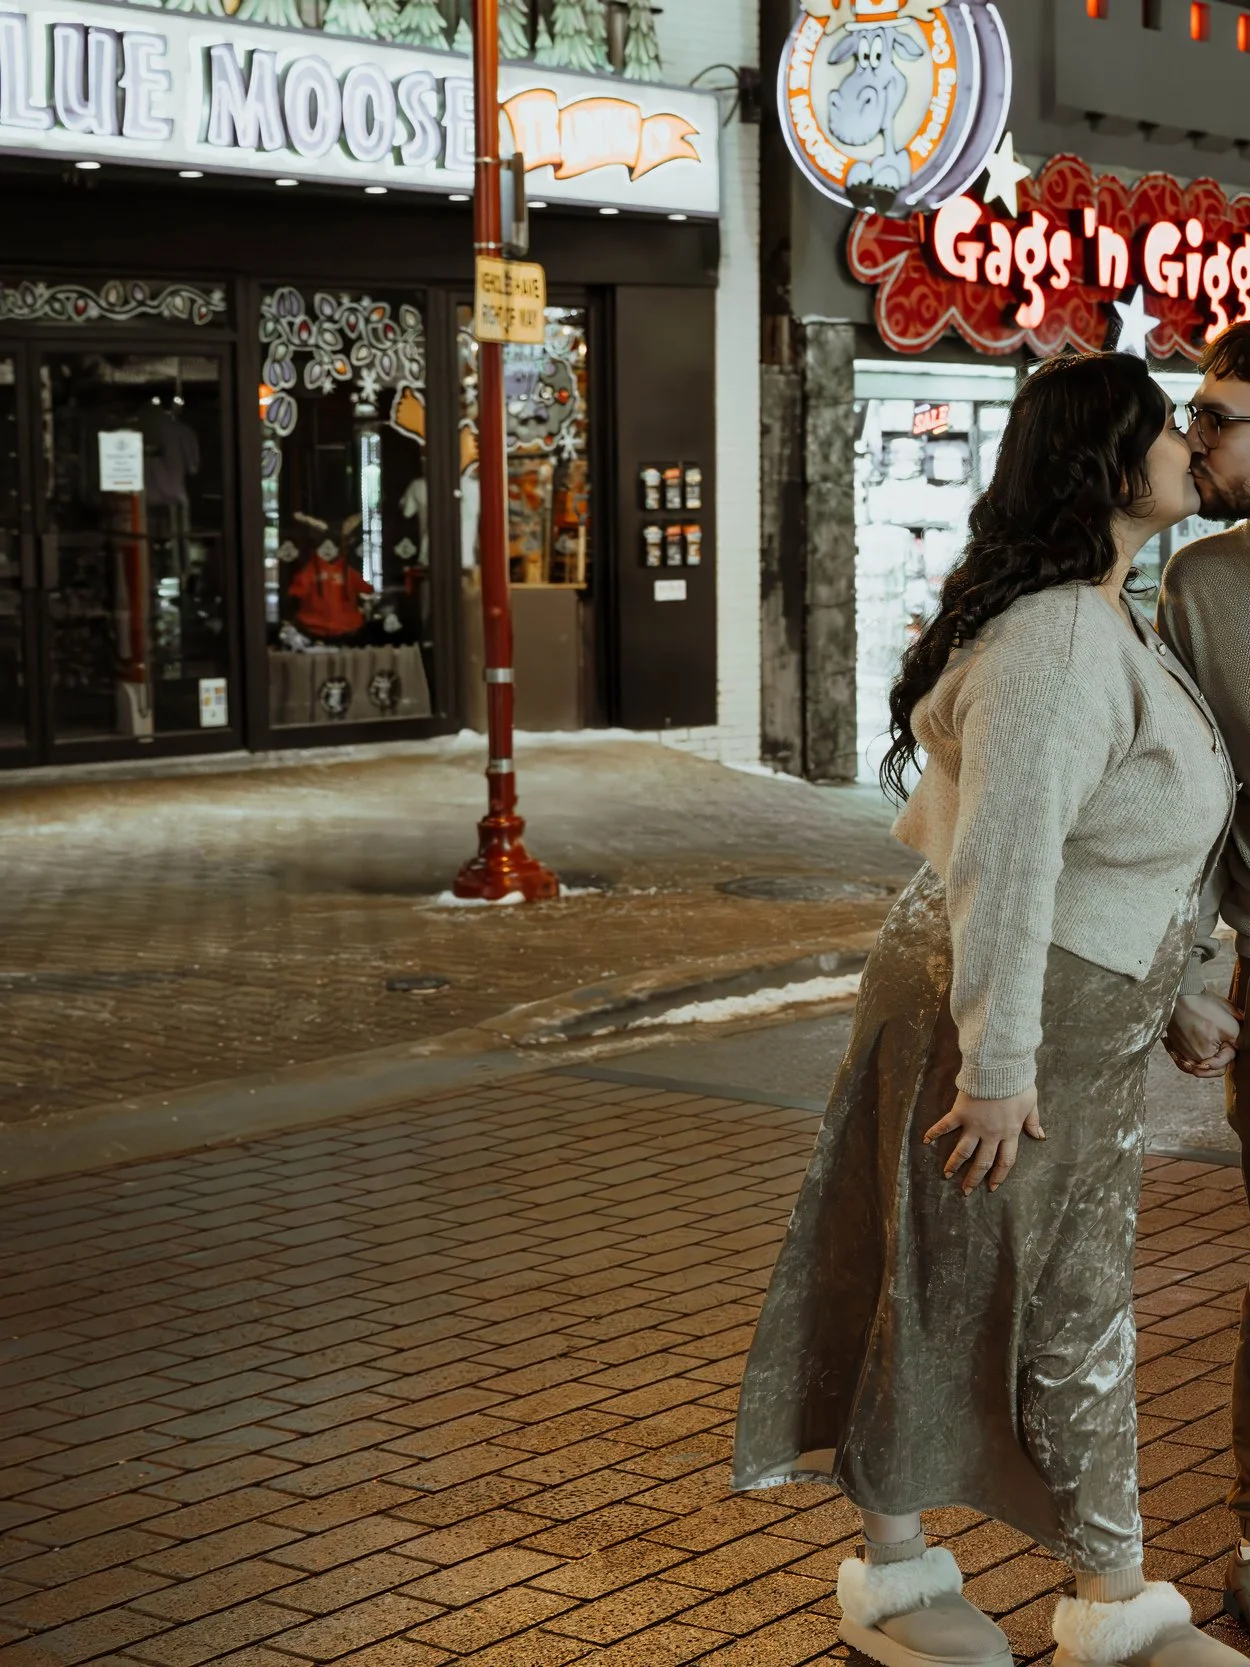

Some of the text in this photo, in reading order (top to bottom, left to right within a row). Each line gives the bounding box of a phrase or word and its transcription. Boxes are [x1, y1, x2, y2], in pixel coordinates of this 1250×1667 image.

[207, 43, 474, 168] MOOSE
[789, 94, 848, 179] MOOSE
[933, 196, 1073, 329] Gags
